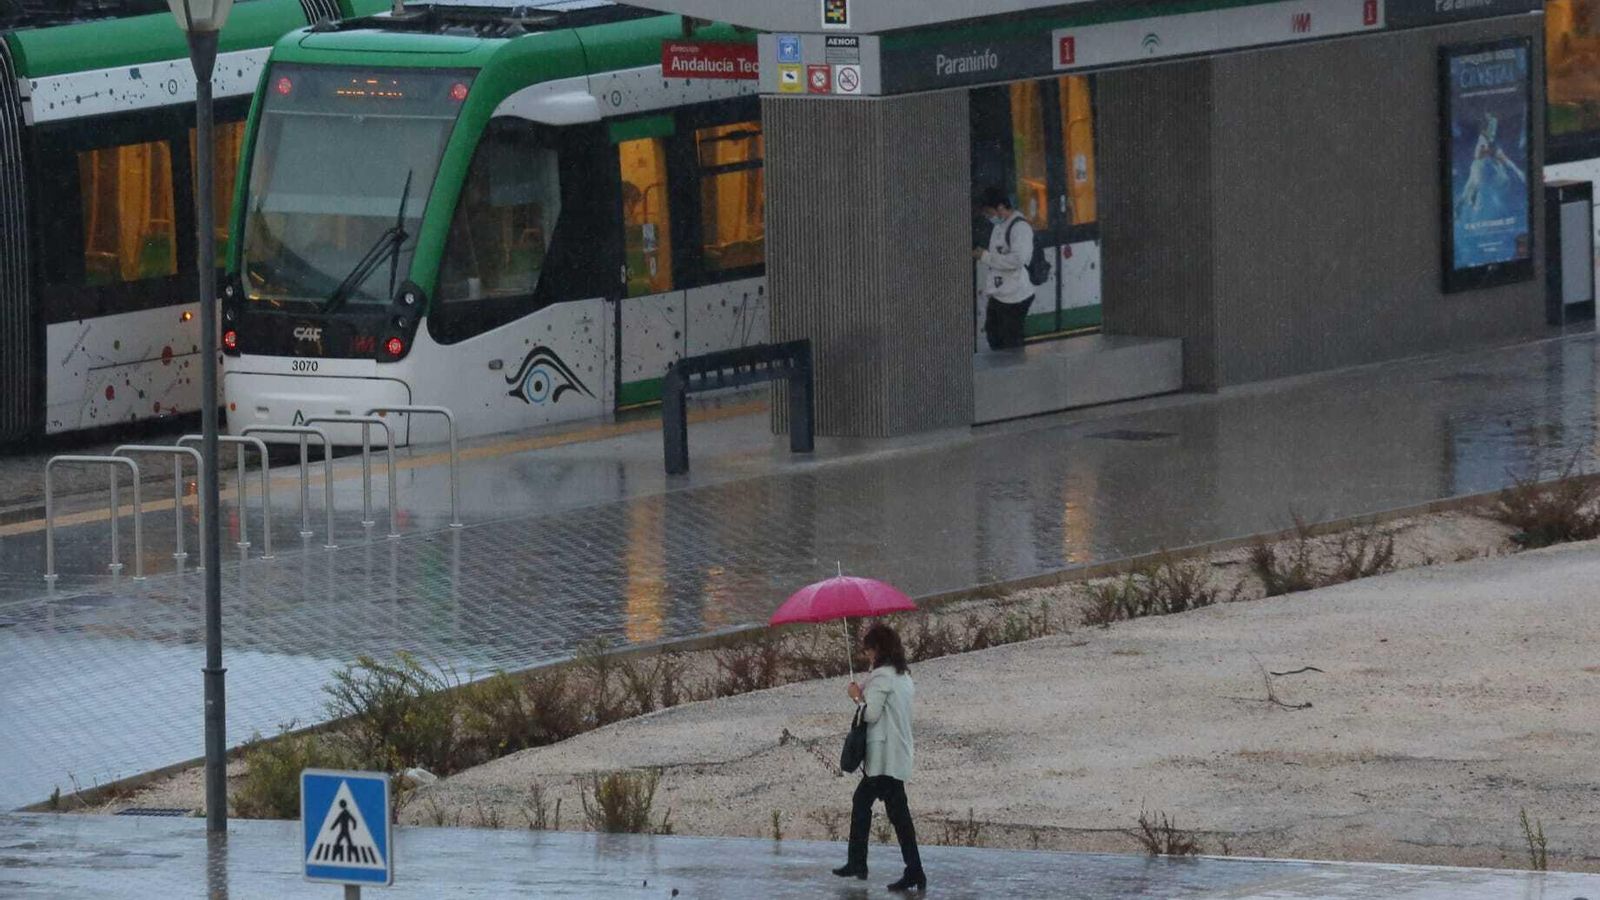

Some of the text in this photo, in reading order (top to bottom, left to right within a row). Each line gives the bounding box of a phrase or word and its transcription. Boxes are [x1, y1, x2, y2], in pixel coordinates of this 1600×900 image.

[827, 38, 856, 46] AENOR
[671, 56, 734, 72] Andalucía
[936, 48, 998, 76] Paraninfo
[293, 326, 323, 342] CAF
[292, 360, 319, 372] 3070
